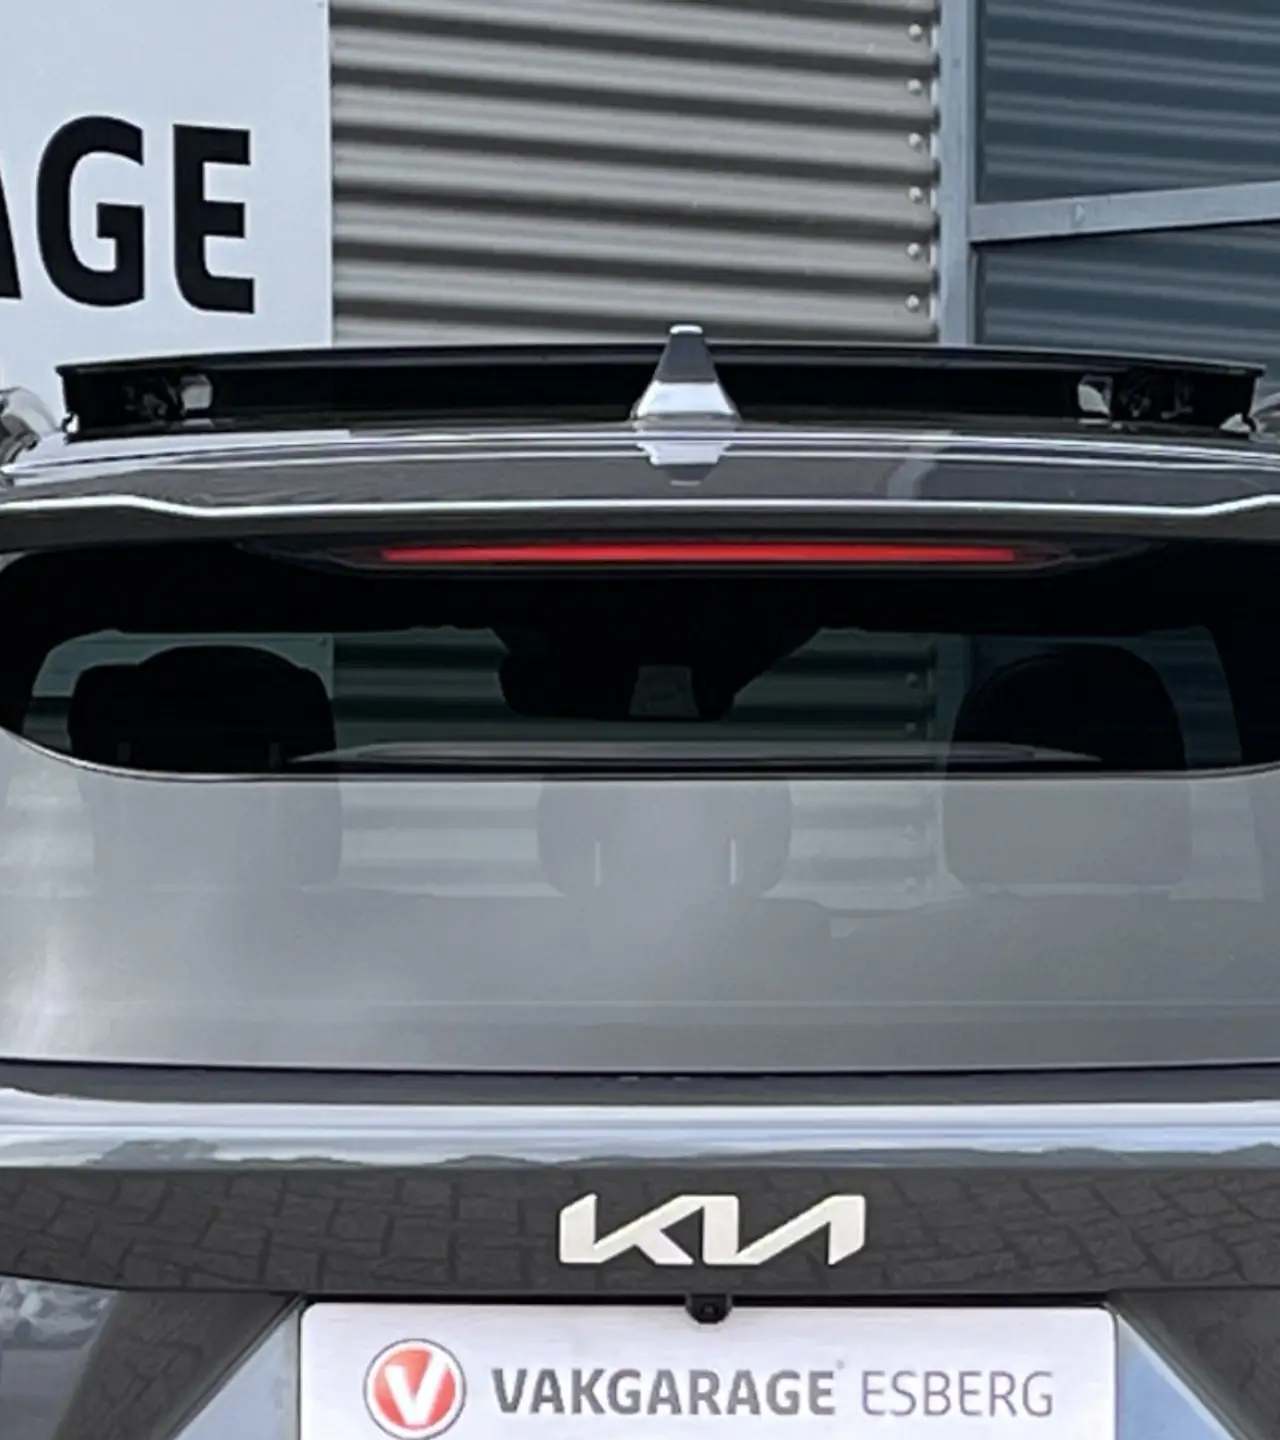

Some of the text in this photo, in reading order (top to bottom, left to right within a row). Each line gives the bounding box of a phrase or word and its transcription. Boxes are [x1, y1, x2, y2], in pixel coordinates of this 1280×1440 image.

[558, 1193, 867, 1265] KIA
[491, 1367, 836, 1417] VAKGARAGE
[861, 1369, 1054, 1418] ESBERG
